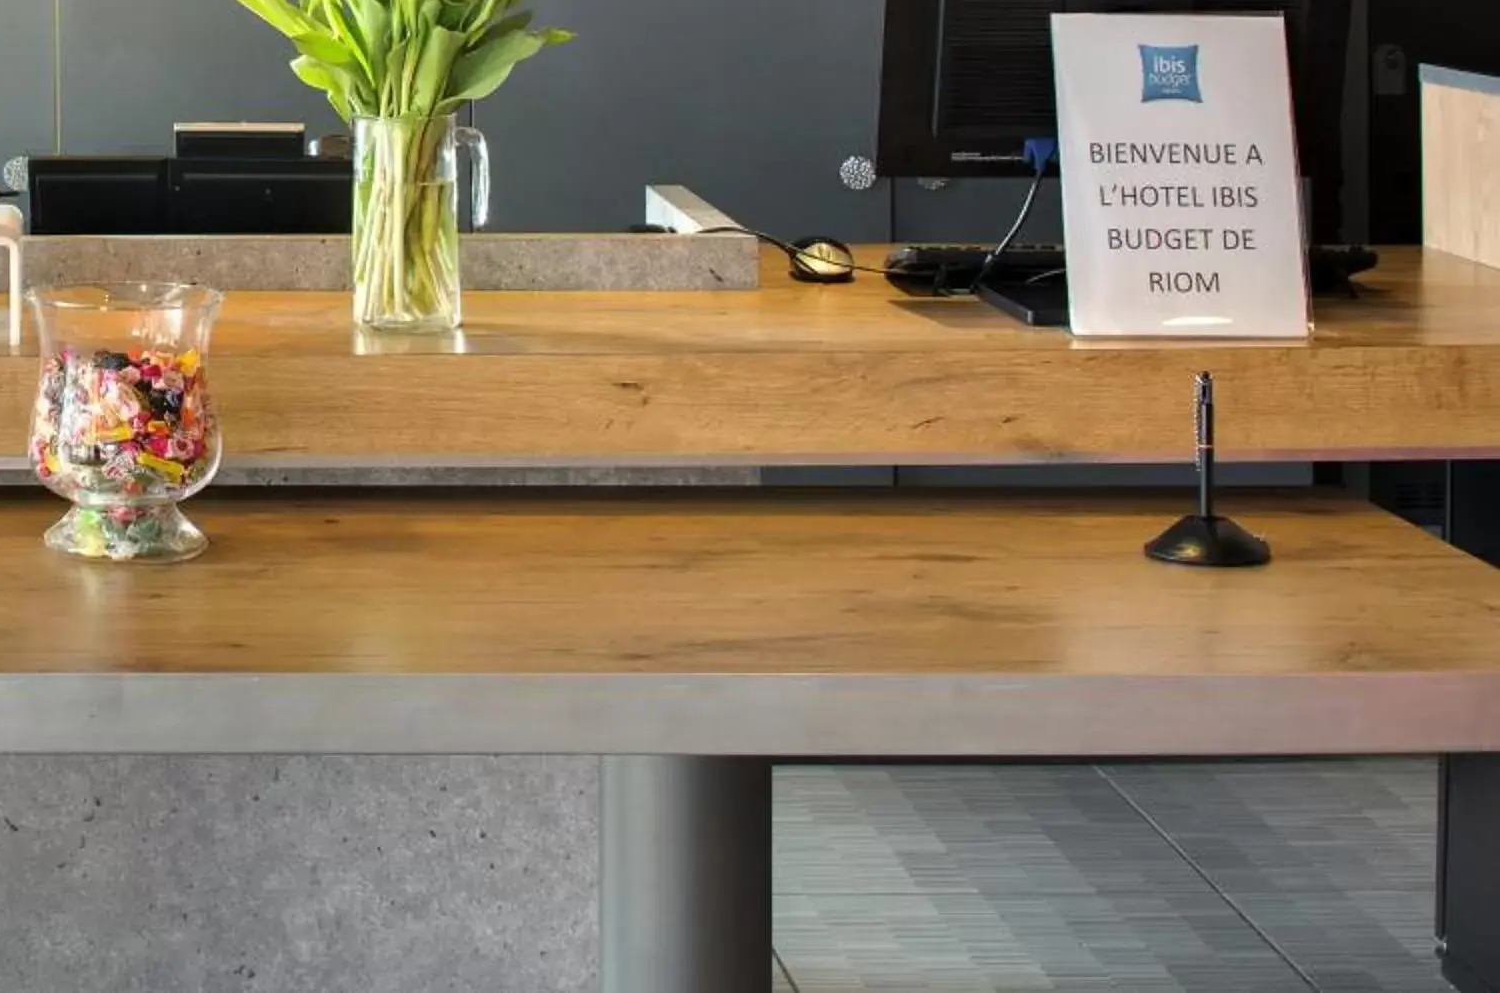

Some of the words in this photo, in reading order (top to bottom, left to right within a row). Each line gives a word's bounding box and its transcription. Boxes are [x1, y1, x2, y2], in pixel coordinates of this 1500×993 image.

[1153, 54, 1186, 73] ibis
[1089, 142, 1237, 165] BIENVENUE
[1245, 143, 1263, 165] A
[1100, 184, 1204, 207] L'HOTEL
[1212, 185, 1259, 208] IBIS
[1107, 227, 1213, 250] BUDGET
[1223, 228, 1257, 250] DE
[1149, 271, 1220, 294] RIOM
